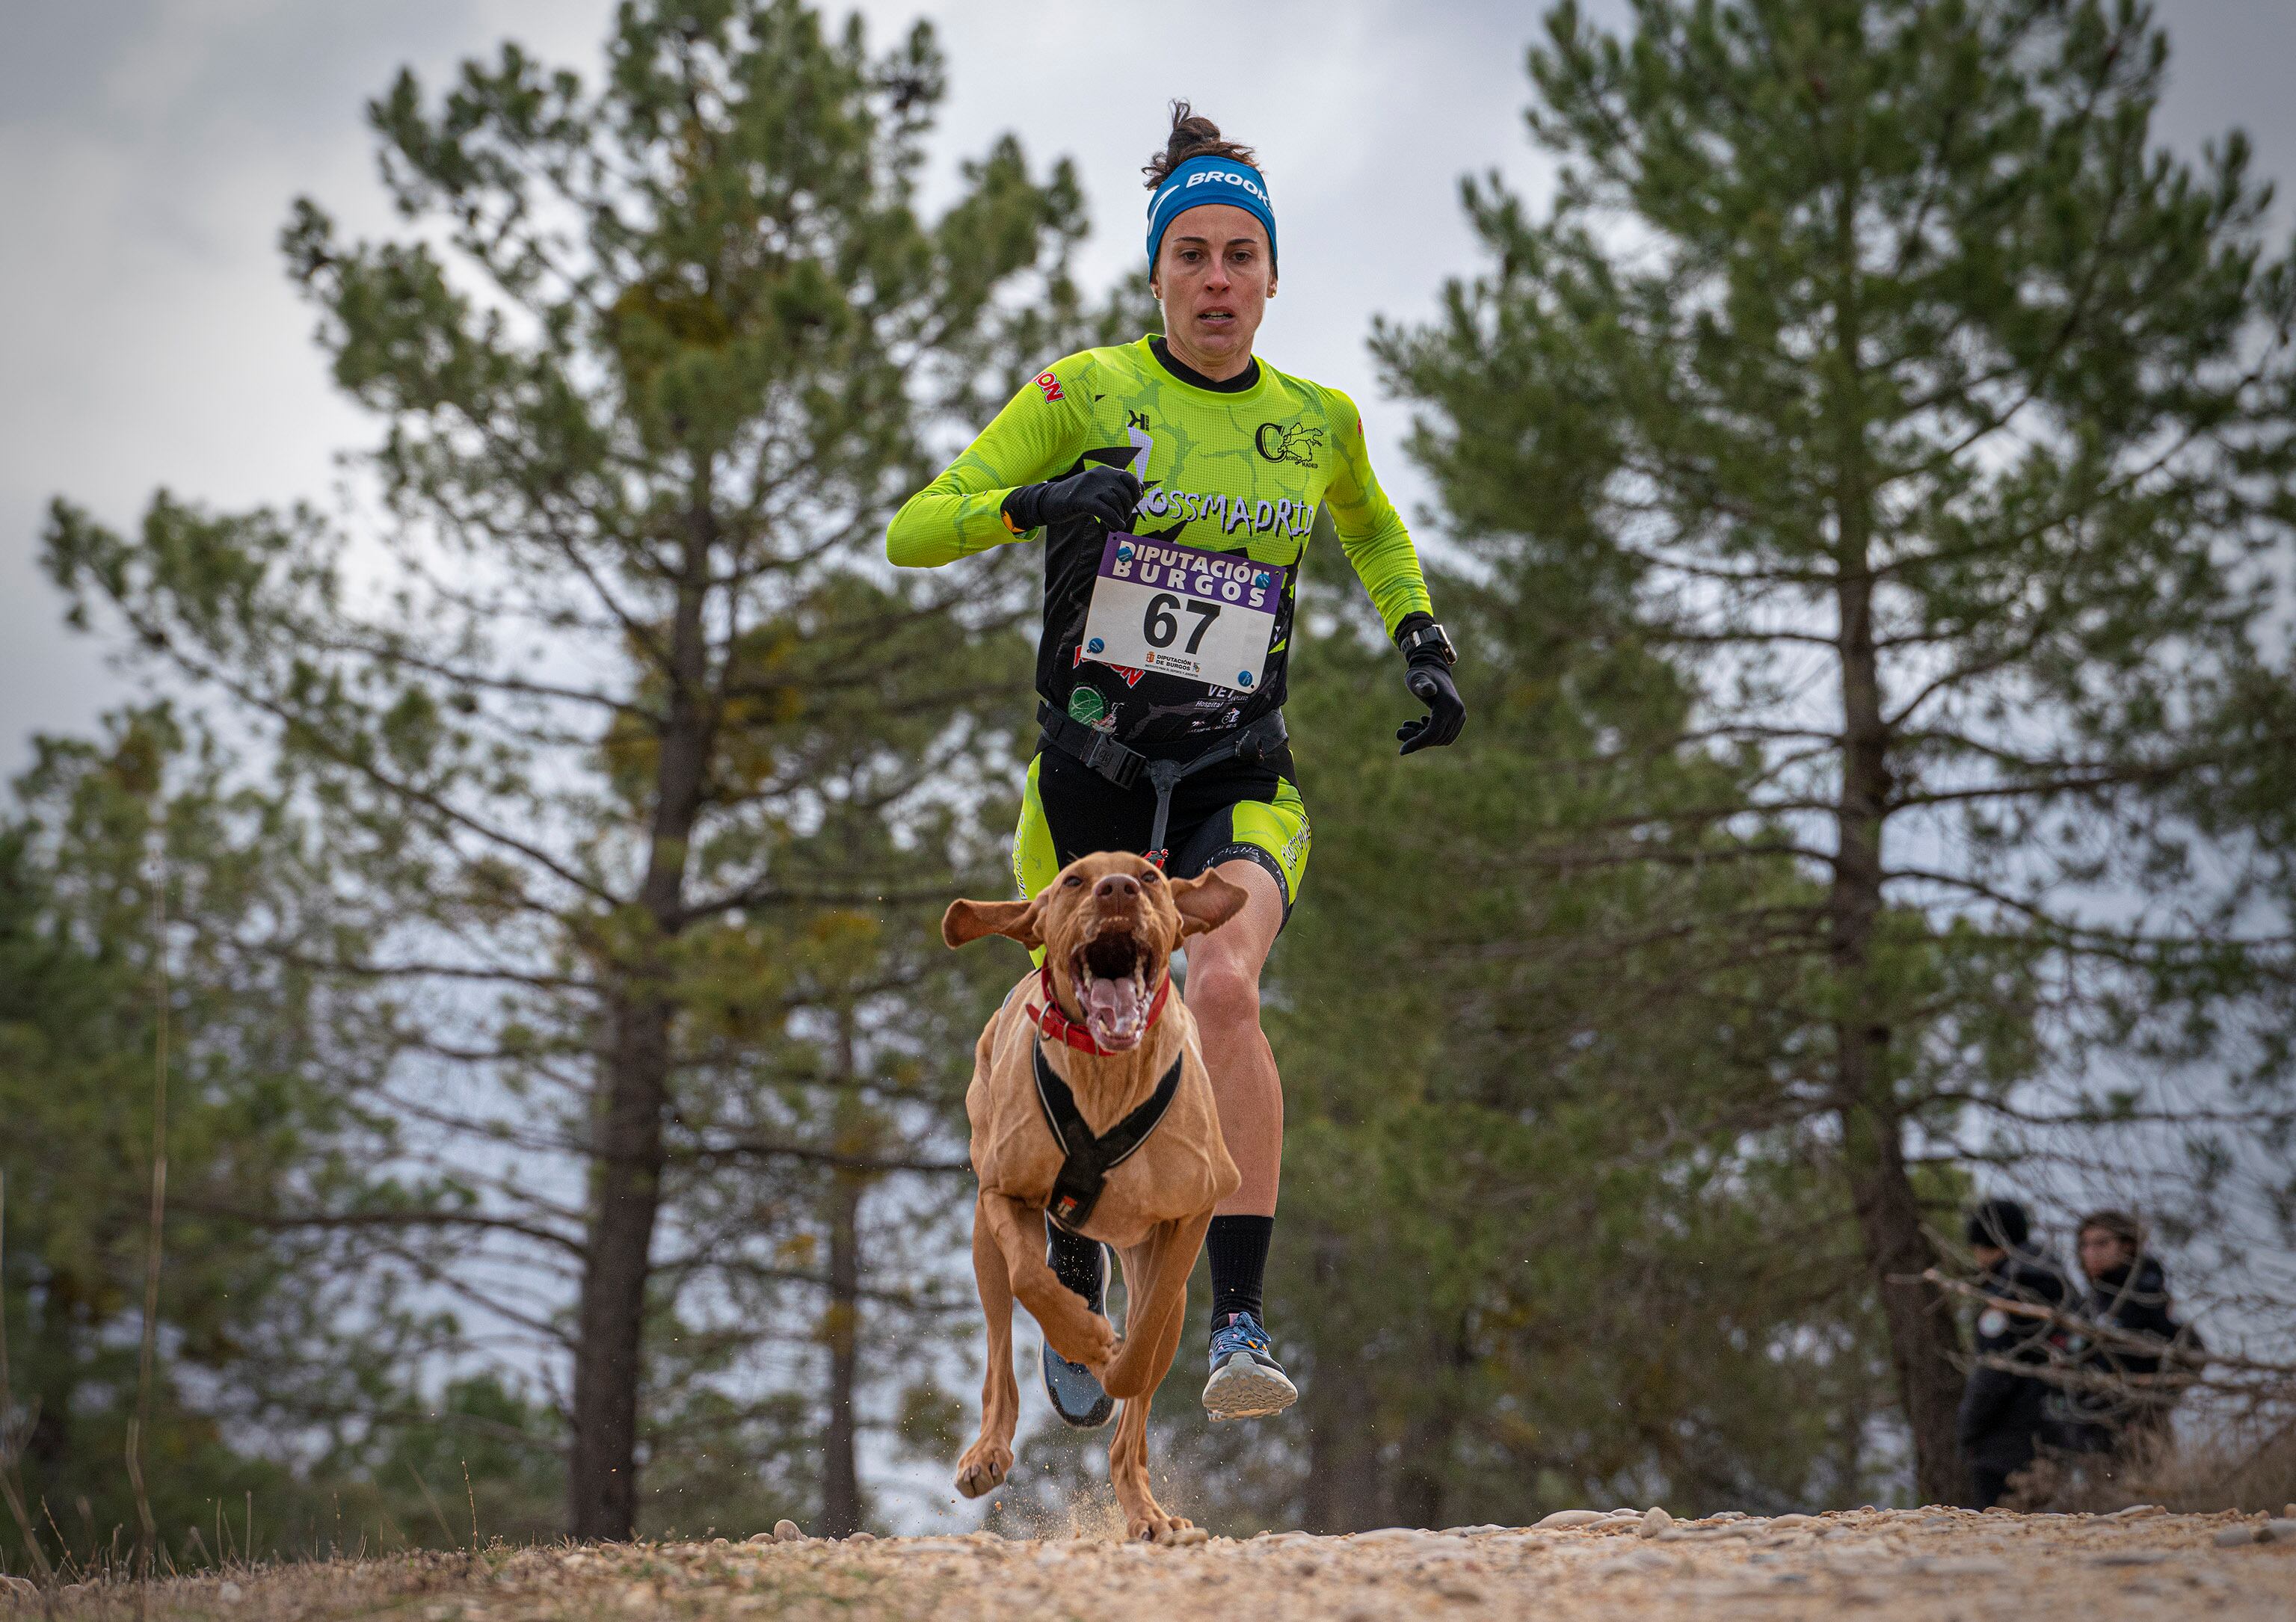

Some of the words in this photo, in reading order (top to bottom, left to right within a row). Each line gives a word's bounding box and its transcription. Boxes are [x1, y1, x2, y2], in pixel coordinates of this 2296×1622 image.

[1112, 559, 1267, 616] BURGOS
[1143, 593, 1222, 655] 67
[1157, 654, 1192, 666] DIPUTACIÓN
[1166, 662, 1191, 671] BURGOS
[1196, 700, 1225, 709] Hospital
